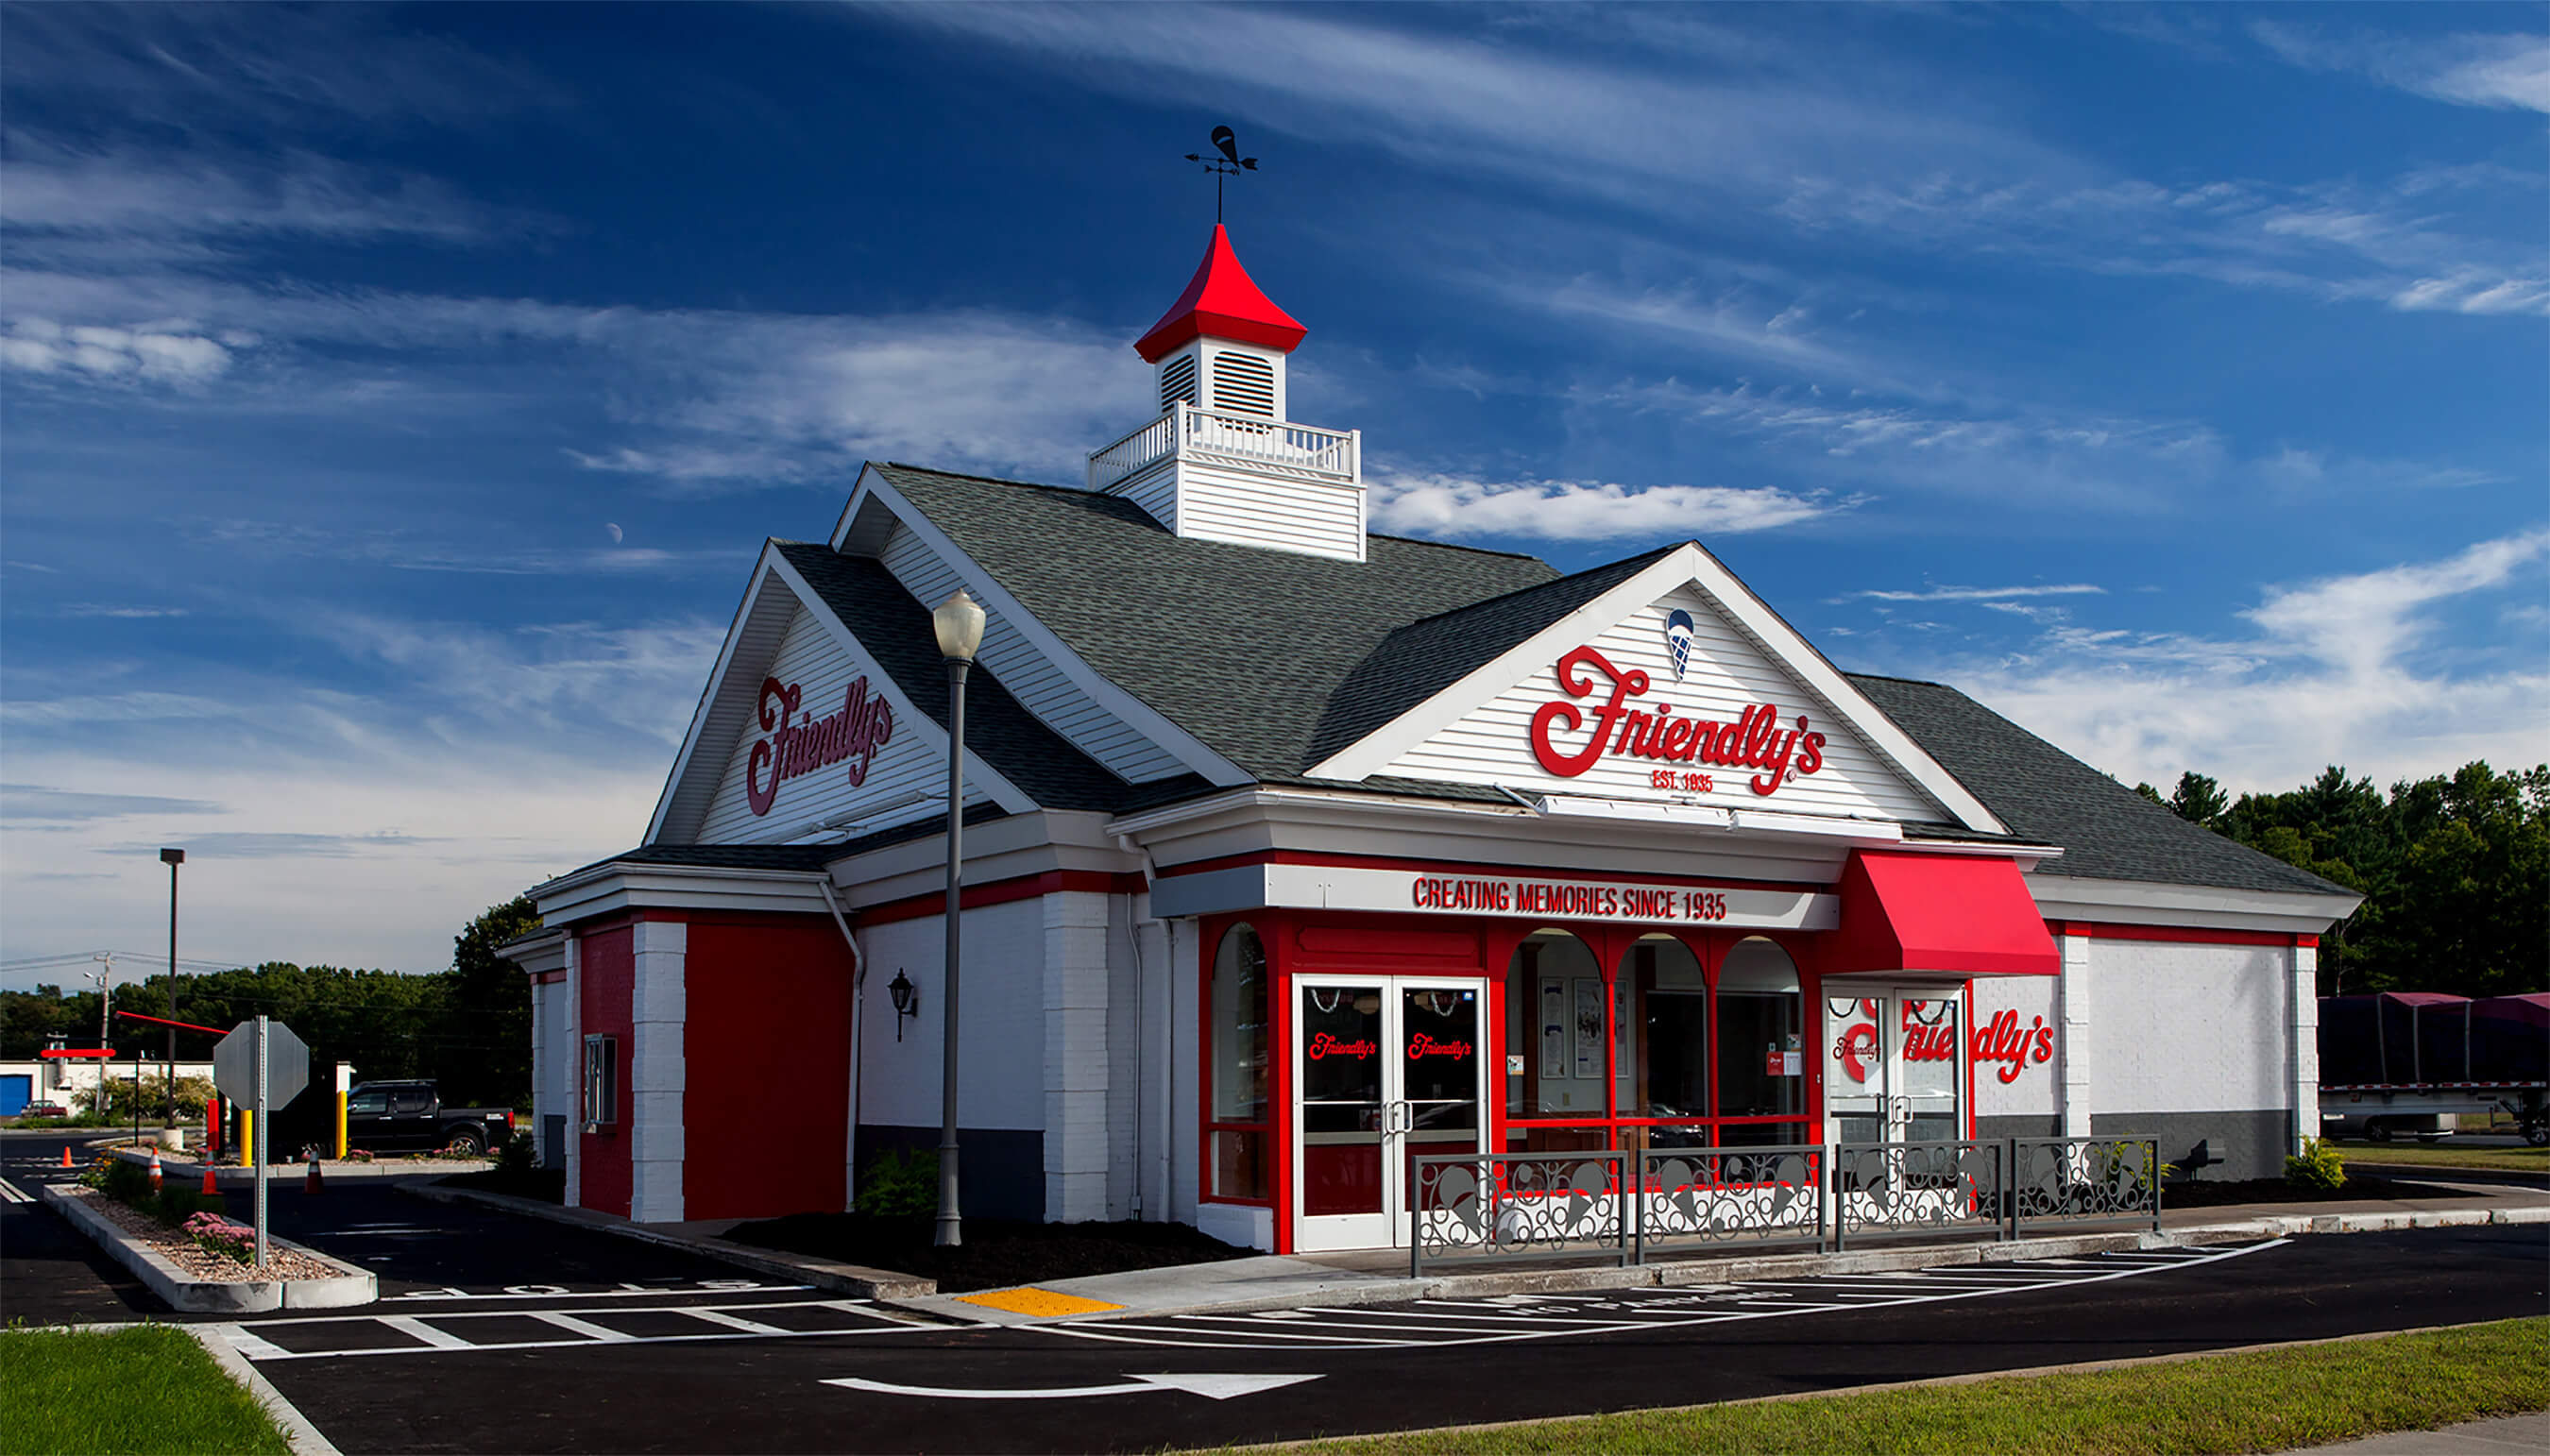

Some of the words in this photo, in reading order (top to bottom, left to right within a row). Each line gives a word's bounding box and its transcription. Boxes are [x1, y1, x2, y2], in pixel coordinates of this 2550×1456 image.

[1531, 646, 1826, 795] Friendly's
[1653, 770, 1678, 789] EST.
[1683, 772, 1713, 791] 1935
[1413, 877, 1509, 909] CREATING
[1516, 883, 1617, 915] MEMORIES
[1623, 889, 1676, 918] SINCE
[1683, 892, 1726, 920] 1935
[1309, 1032, 1376, 1060] Friendly's
[1407, 1033, 1471, 1060] Friendly's
[1843, 997, 2053, 1084] riedly's
